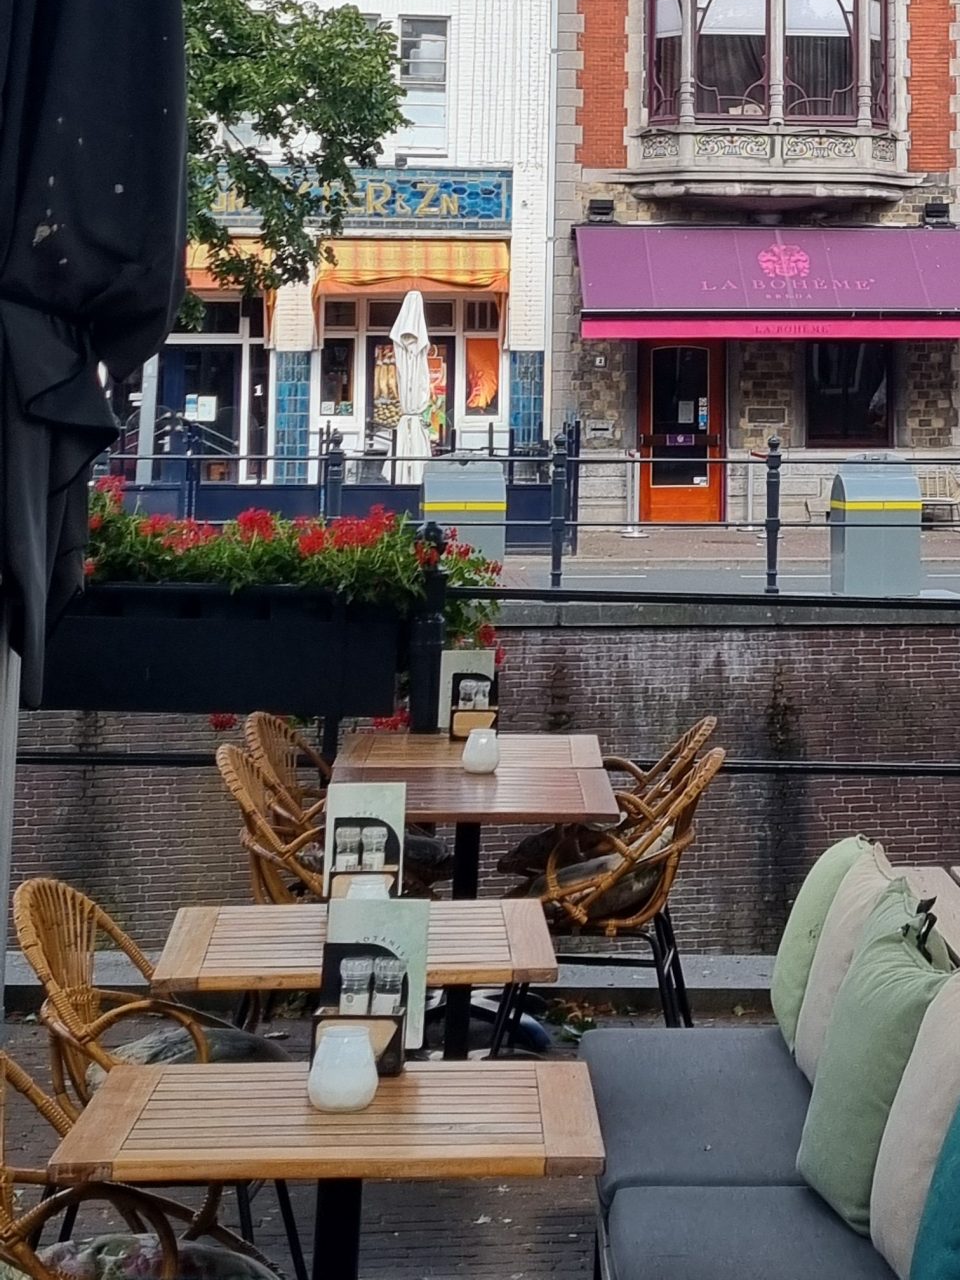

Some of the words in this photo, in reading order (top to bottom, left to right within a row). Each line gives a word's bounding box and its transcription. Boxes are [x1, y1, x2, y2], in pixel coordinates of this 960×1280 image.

[701, 279, 738, 291] LA
[755, 325, 770, 334] LA
[254, 384, 263, 396] 1
